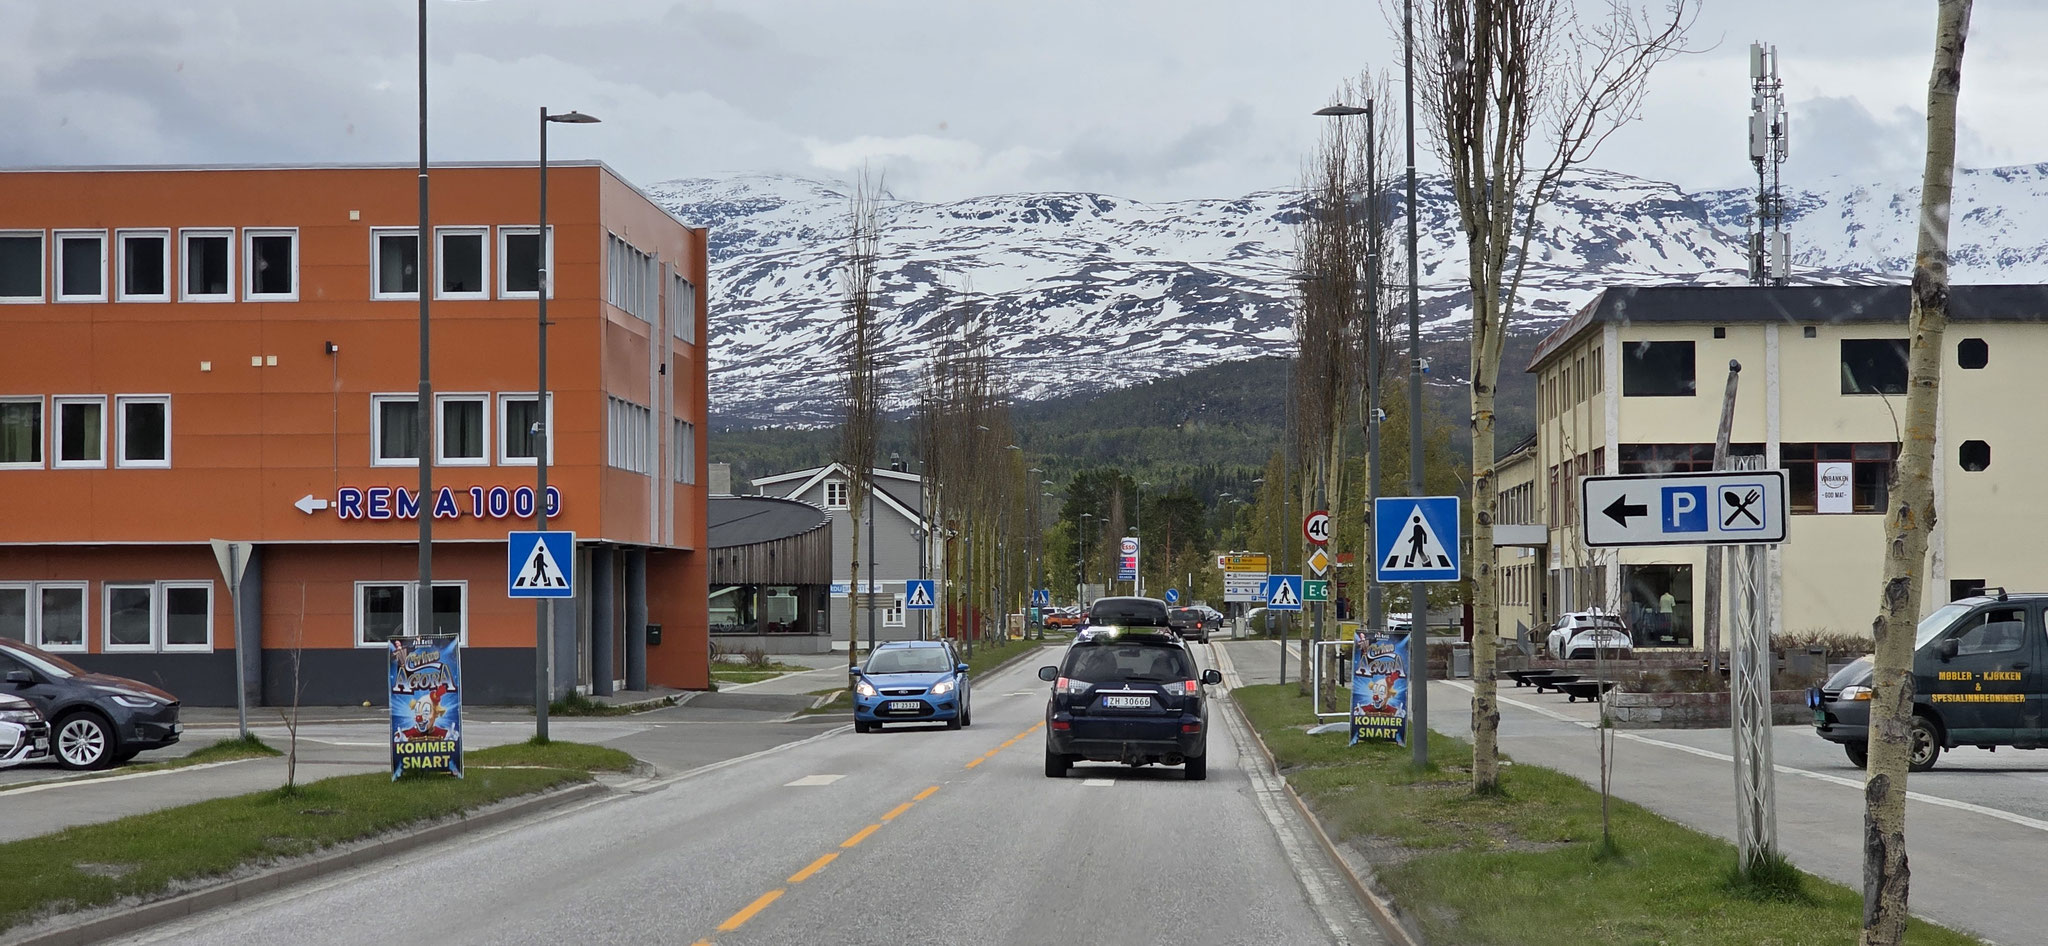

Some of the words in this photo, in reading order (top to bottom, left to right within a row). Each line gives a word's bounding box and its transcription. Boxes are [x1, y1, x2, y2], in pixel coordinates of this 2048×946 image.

[337, 486, 461, 520] REMA
[469, 486, 562, 519] 1000
[1673, 492, 1696, 527] P
[1310, 520, 1328, 536] 40
[1355, 655, 1406, 677] AGORA
[393, 664, 456, 693] AGORA
[1938, 671, 1972, 680] MØBLER
[1983, 671, 2021, 680] KJØKKEN
[1975, 682, 1982, 692] &
[1109, 697, 1120, 705] ZH
[1124, 697, 1150, 705] 30666
[1354, 716, 1403, 727] KOMMER
[1358, 728, 1398, 739] SNART
[396, 741, 456, 754] KOMMER
[402, 755, 451, 769] SNART
